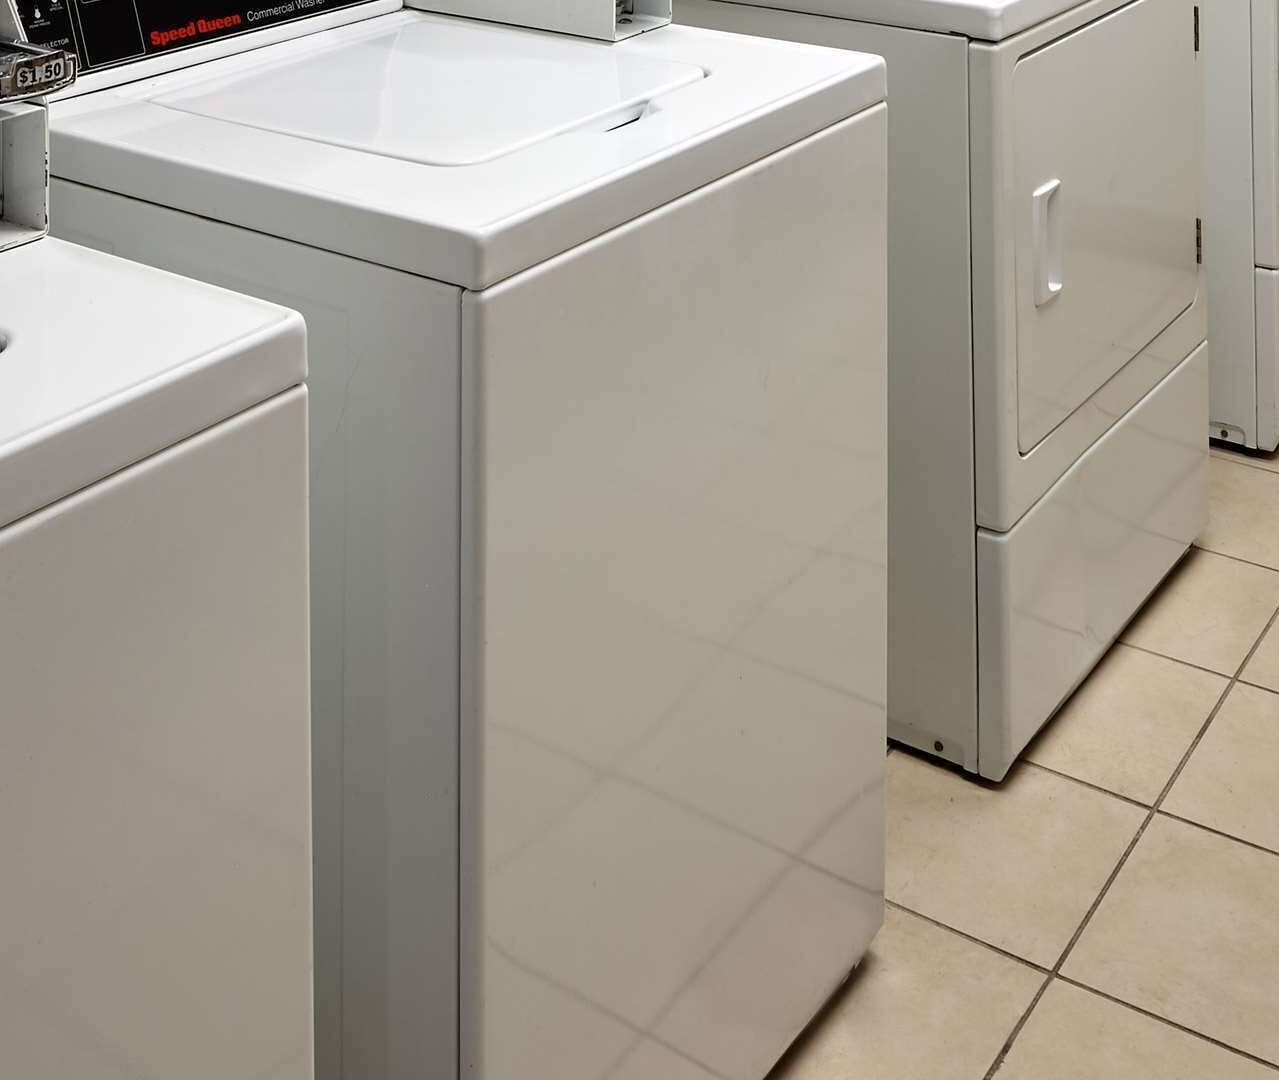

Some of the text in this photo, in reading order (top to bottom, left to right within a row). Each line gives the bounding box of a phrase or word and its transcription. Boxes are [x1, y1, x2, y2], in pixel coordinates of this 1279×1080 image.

[150, 23, 196, 46] Speed
[197, 13, 242, 33] Queen
[246, 1, 295, 22] Commercial
[19, 62, 62, 85] $1.50
